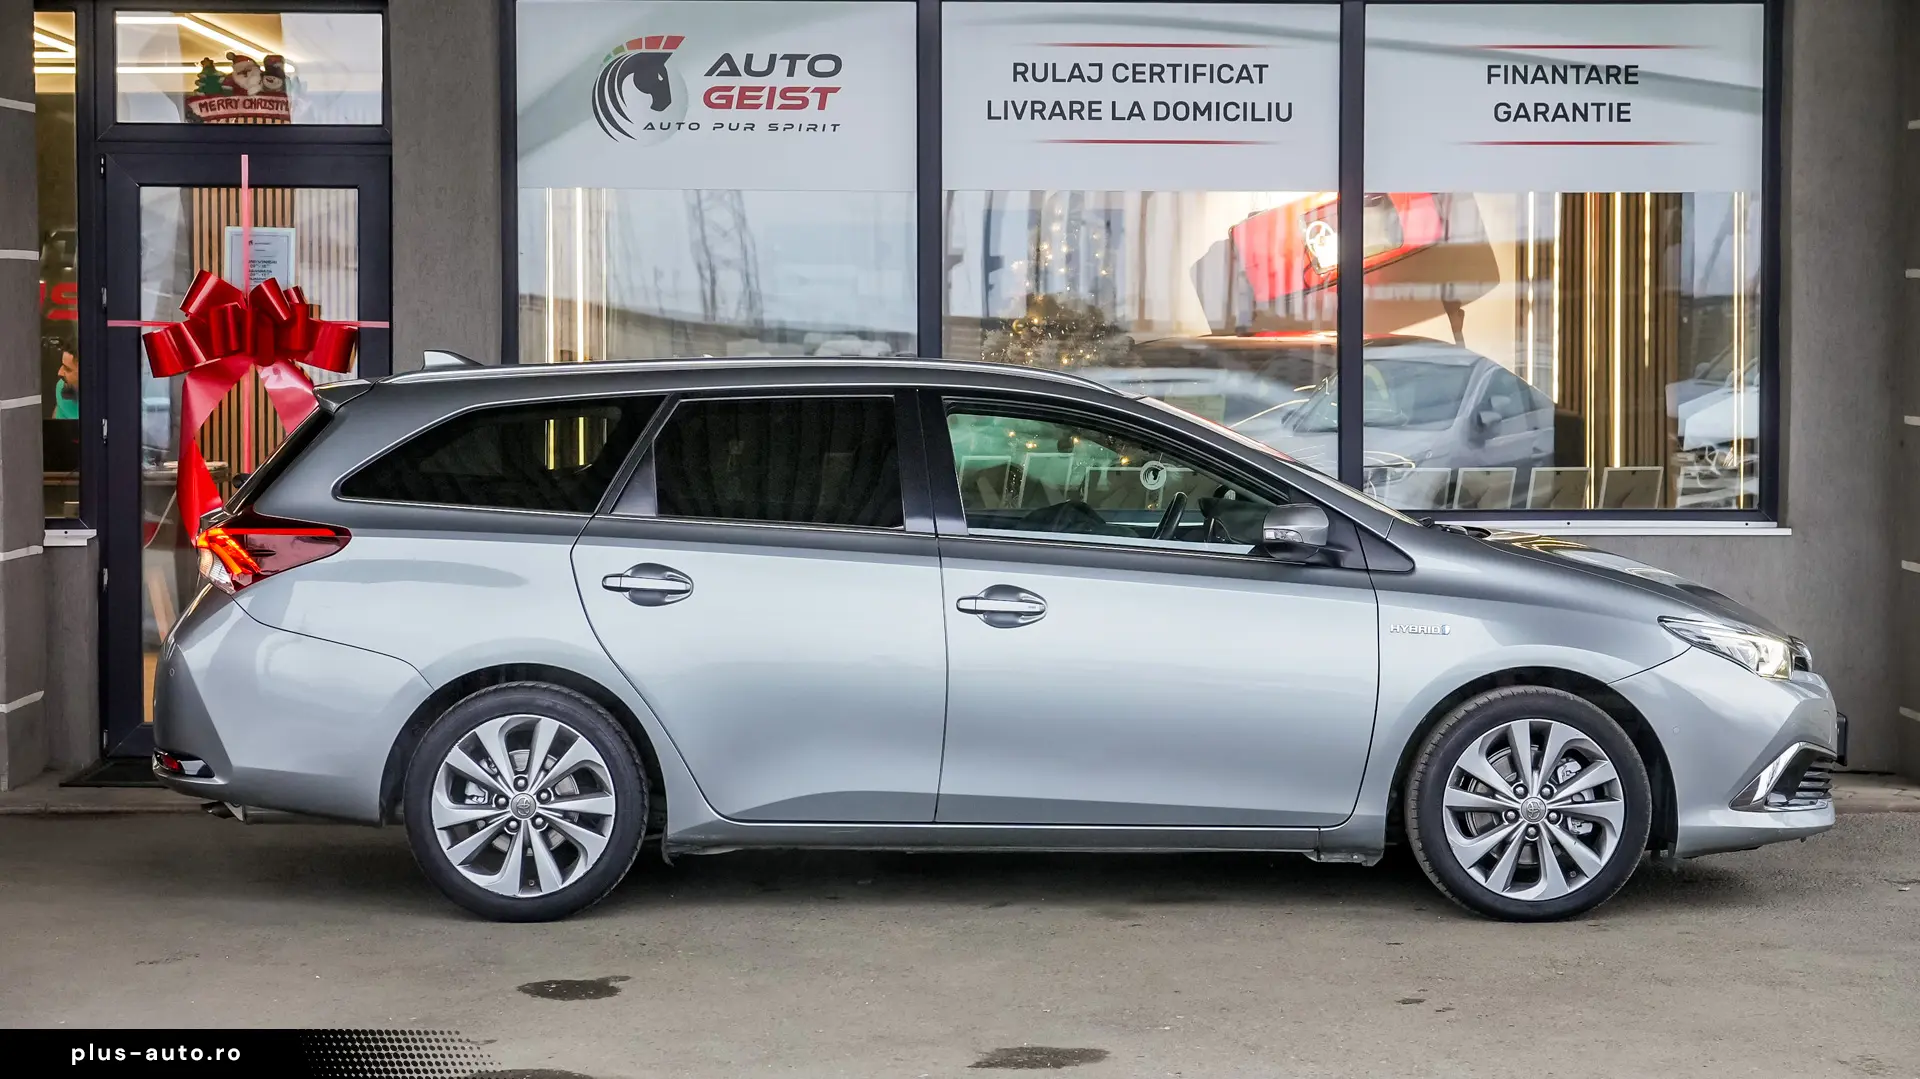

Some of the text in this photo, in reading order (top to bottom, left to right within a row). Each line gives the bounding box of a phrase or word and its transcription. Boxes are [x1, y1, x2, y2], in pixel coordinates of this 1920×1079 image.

[704, 53, 843, 78] AUTO
[1012, 63, 1269, 84] RULAJ CERTIFICAT
[1487, 64, 1639, 85] FINANTARE
[199, 99, 240, 113] MERRY
[702, 86, 842, 111] GEIST
[987, 100, 1293, 123] LIVRARE LA DOMICILIU
[1493, 102, 1632, 123] GARANTIE
[643, 121, 841, 132] AUTO PUR SPIRIT
[1390, 624, 1441, 635] HYBRID
